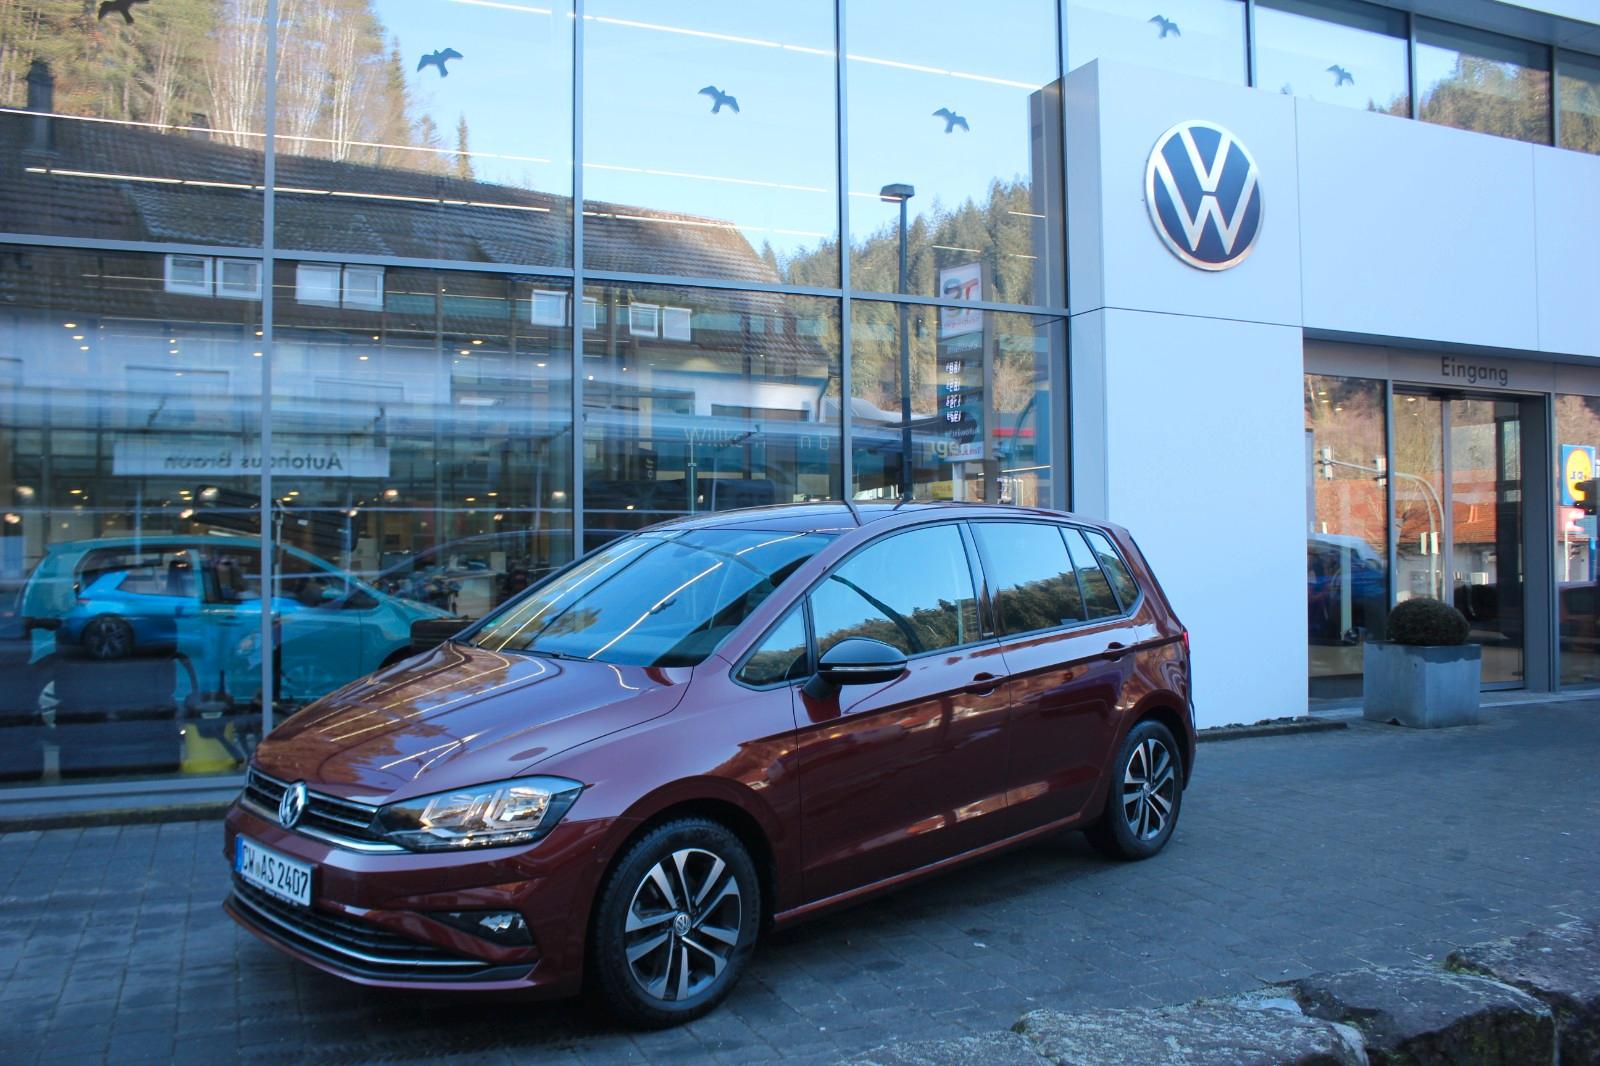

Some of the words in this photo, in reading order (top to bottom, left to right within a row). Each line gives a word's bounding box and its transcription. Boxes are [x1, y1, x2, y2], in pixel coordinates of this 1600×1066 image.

[1146, 121, 1263, 269] VW
[1441, 355, 1508, 386] Eingang
[243, 845, 256, 875] CW
[261, 853, 275, 885] AS
[277, 861, 309, 898] 2407
